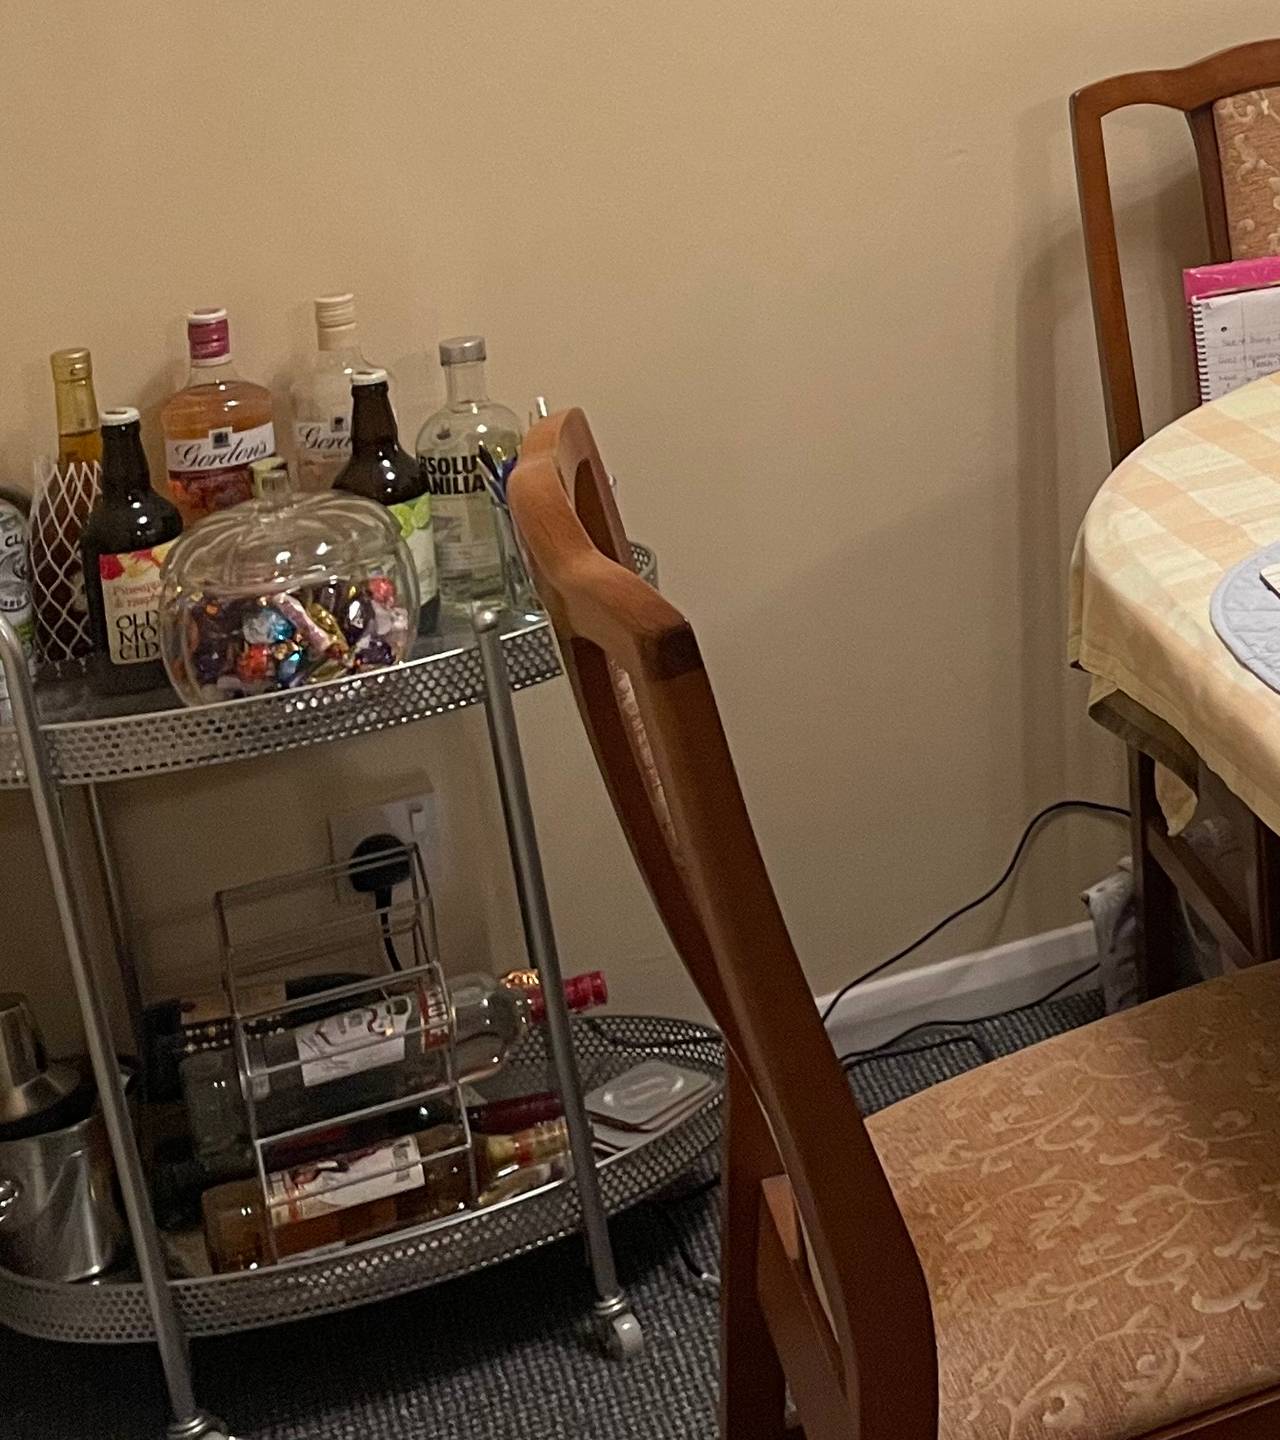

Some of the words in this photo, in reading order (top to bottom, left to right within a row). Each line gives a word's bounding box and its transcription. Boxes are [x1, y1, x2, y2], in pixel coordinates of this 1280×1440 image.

[174, 435, 268, 468] Gordon's
[418, 455, 477, 475] BSOLU
[119, 625, 157, 646] MO
[119, 642, 160, 660] CID
